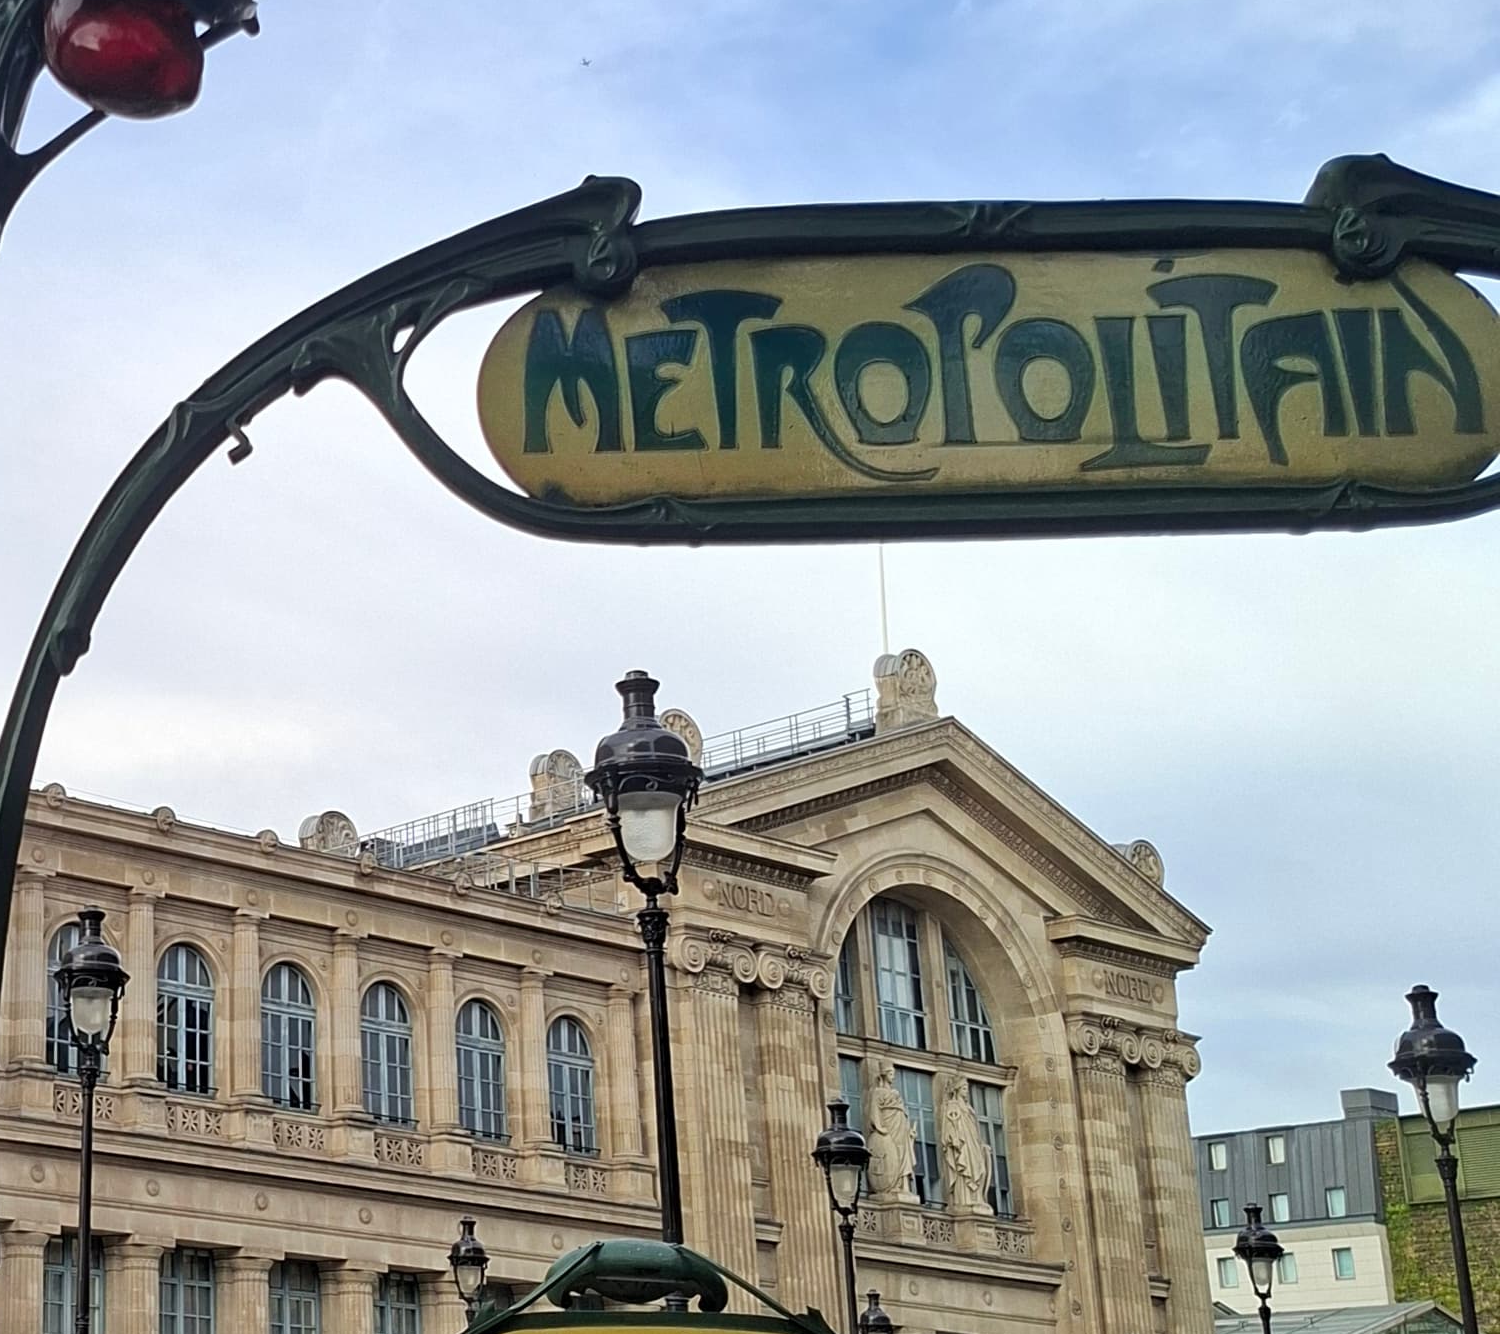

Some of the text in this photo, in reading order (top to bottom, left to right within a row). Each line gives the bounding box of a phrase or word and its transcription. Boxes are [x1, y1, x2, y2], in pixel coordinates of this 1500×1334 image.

[523, 263, 1485, 480] METROPOLITAIN
[716, 879, 775, 917] NORD
[1103, 969, 1152, 1003] NORD
